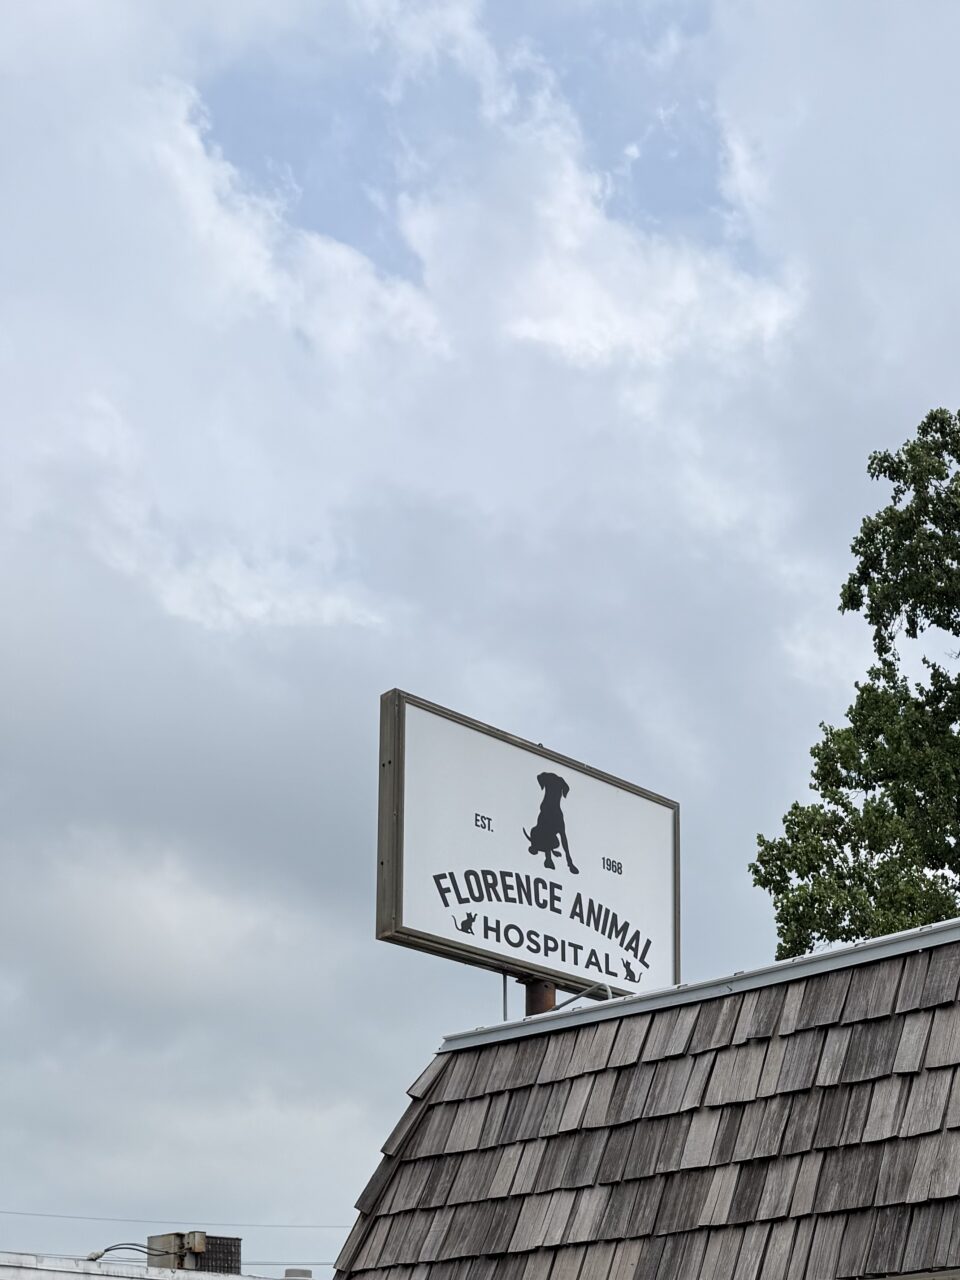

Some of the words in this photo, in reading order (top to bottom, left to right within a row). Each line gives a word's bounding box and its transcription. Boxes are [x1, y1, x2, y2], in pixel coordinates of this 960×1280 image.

[474, 813, 494, 832] EST.
[601, 856, 623, 875] 1968
[432, 869, 563, 914] FLORENCE
[569, 892, 653, 969] ANIMAL
[483, 915, 618, 977] HOSPITAL
